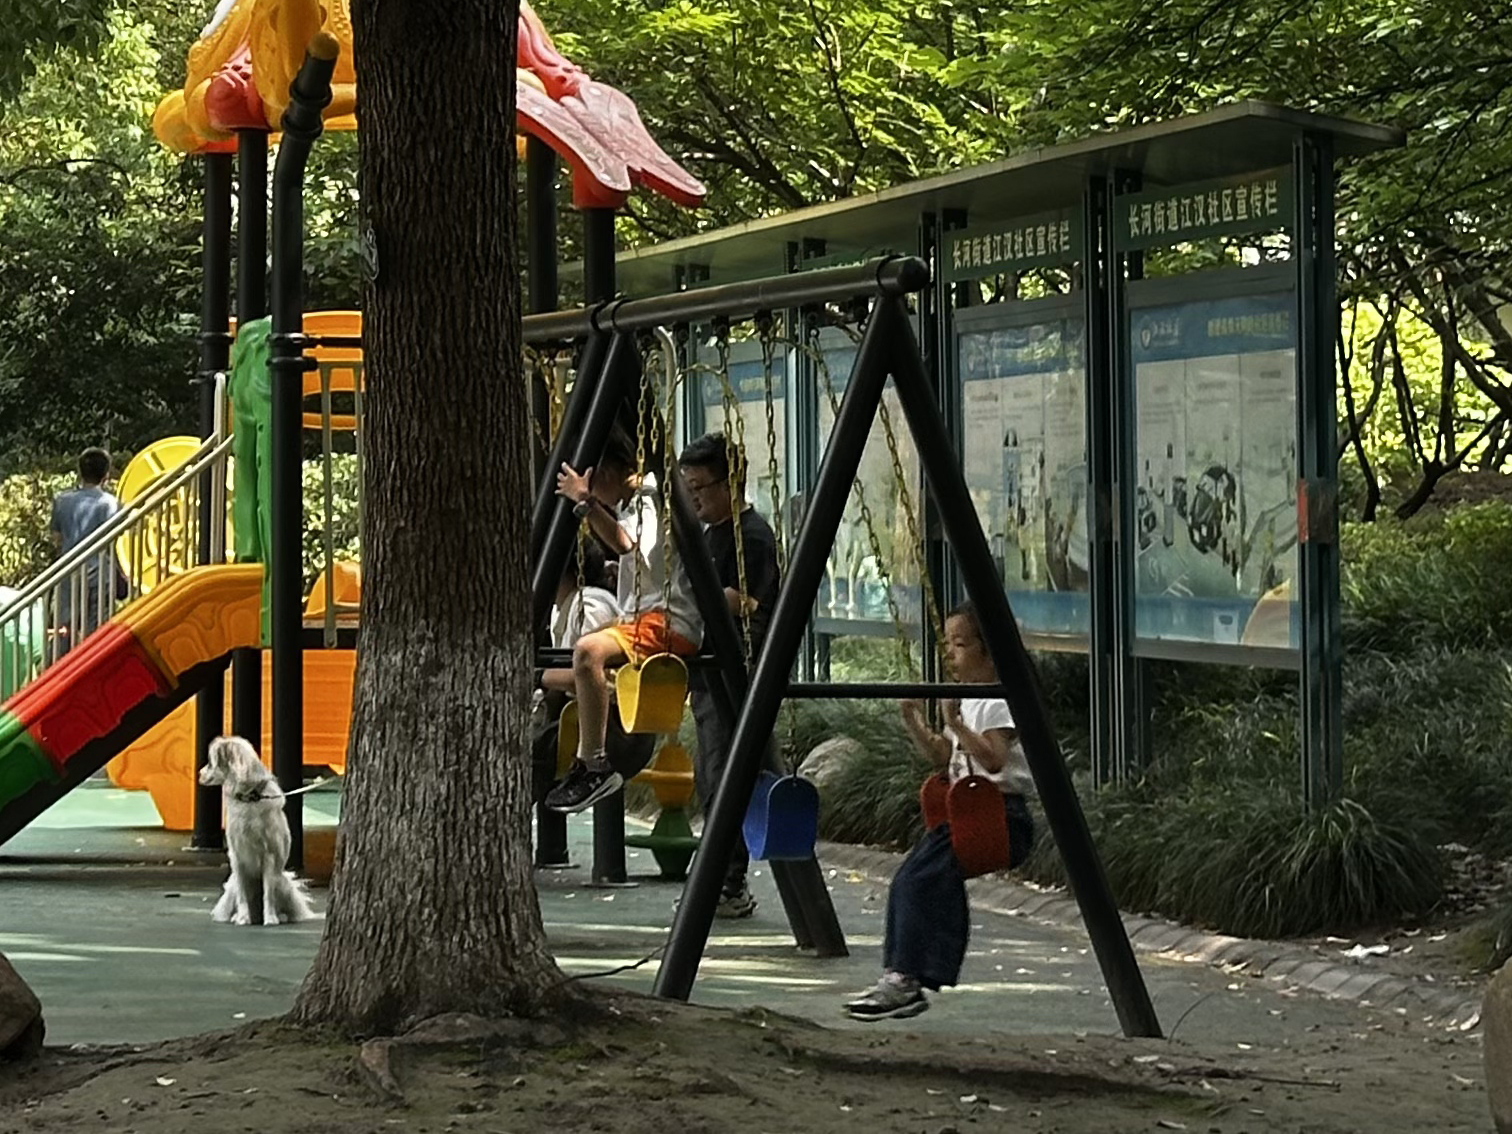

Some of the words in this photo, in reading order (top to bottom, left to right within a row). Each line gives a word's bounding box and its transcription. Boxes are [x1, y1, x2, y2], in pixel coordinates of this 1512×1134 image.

[1128, 179, 1278, 239] 长河街道江汉社区宣传栏
[952, 219, 1070, 270] 长河街道江汉社区宣传栏
